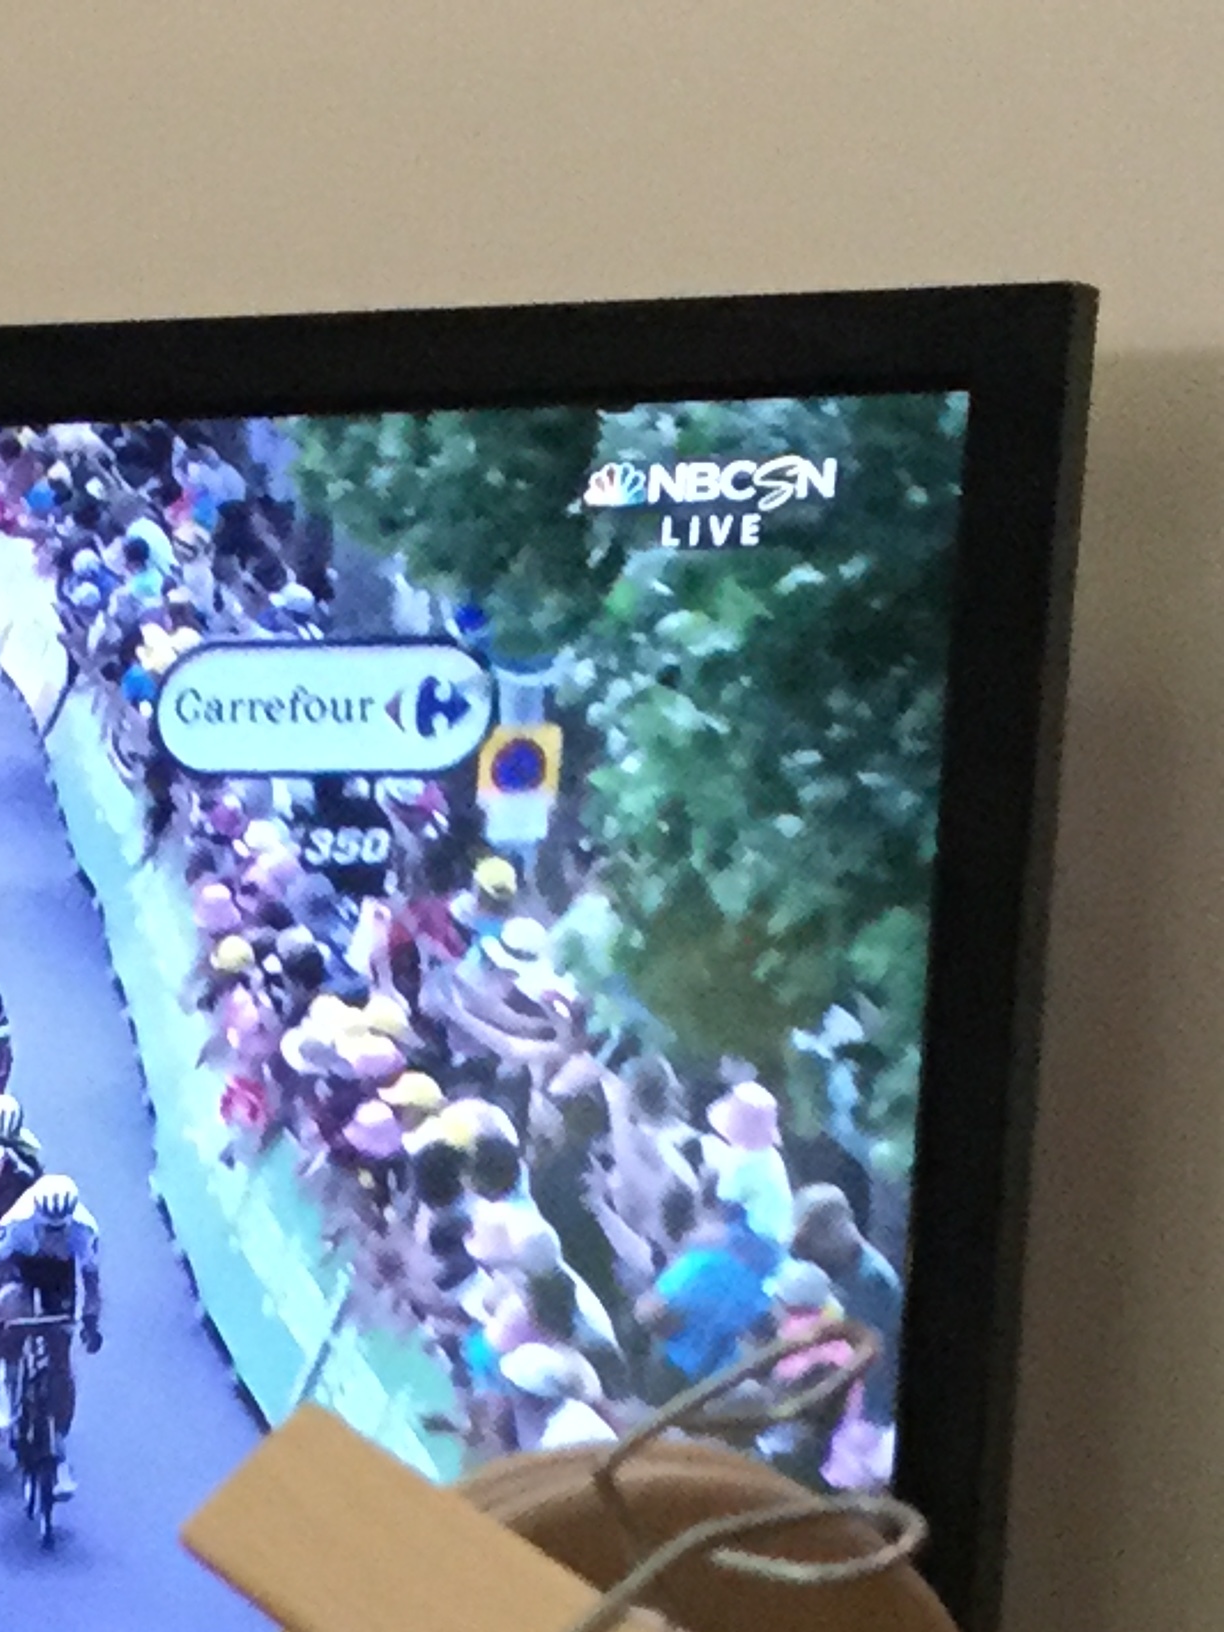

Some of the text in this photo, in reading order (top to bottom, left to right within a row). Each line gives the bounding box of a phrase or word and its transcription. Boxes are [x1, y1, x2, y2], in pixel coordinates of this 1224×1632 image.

[647, 455, 837, 511] NBCSN
[661, 514, 761, 546] LIVE
[175, 684, 376, 726] Carrefour
[305, 827, 391, 865] 350
